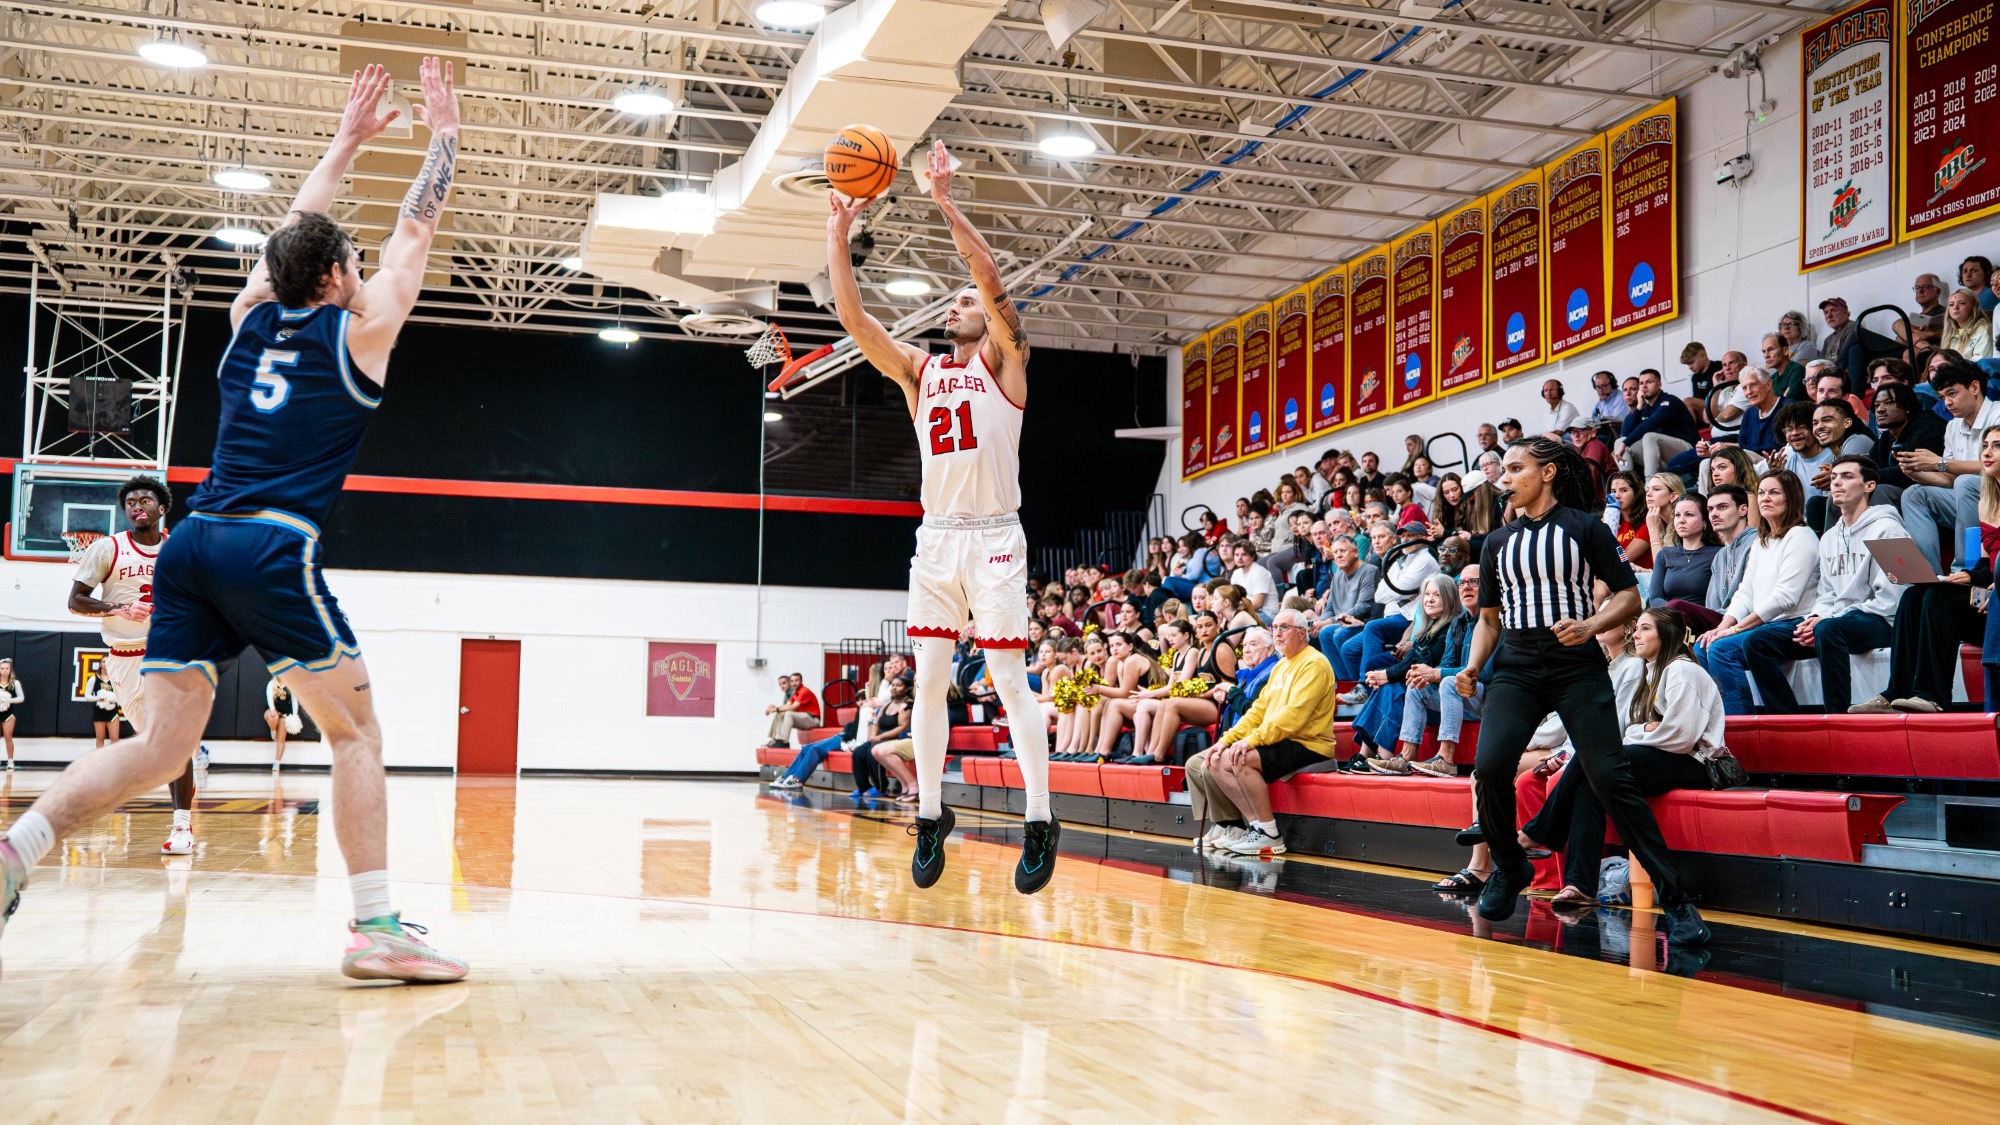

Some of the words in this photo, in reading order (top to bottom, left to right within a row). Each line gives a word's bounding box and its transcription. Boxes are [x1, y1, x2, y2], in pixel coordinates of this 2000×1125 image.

[1806, 9, 1889, 76] FLAGLER
[1917, 3, 1994, 52] CONFERENCE
[1920, 26, 1989, 68] CHAMPIONS
[1814, 52, 1880, 95] INSTITUTION
[1914, 89, 1936, 109] 2013
[1944, 77, 1966, 97] 2018
[1975, 64, 1997, 85] 2019
[1812, 96, 1824, 113] OF
[1829, 85, 1849, 107] THE
[1854, 71, 1881, 95] YEAR
[1914, 107, 1936, 127] 2020
[1944, 96, 1966, 116] 2021
[1974, 83, 1997, 104] 2022
[1812, 117, 1842, 139] 2010-11
[1850, 100, 1882, 124] 2011-12
[1812, 134, 1842, 156] 2012-13
[1850, 117, 1882, 141] 2013-14
[1914, 125, 1936, 144] 2023
[1943, 114, 1966, 134] 2024
[1612, 116, 1672, 171] FLAGLER
[1813, 150, 1843, 172] 2014-15
[1850, 135, 1882, 158] 2015-16
[1548, 149, 1602, 203] FLAGLER
[1615, 160, 1669, 195] CHAMPIONSHIP
[1622, 149, 1659, 176] NATIONAL
[1813, 167, 1843, 188] 2017-18
[1850, 151, 1883, 175] 2018-19
[1935, 144, 1974, 192] PBC
[424, 200, 437, 219] OF
[433, 161, 452, 201] ONE
[1558, 181, 1591, 207] NATIONAL
[1616, 176, 1668, 209] APPEARANCES
[1910, 207, 1941, 226] WOMEN'S
[1943, 199, 1964, 215] CROSS
[1966, 186, 2000, 208] COUNTRY
[1492, 184, 1540, 232] FLAGLER
[1551, 190, 1600, 225] CHAMPIONSHIP
[1553, 206, 1600, 239] APPEARANCES
[1616, 209, 1630, 224] 2018
[1635, 201, 1649, 216] 2019
[1654, 193, 1668, 208] 2024
[1829, 187, 1861, 228] PBC
[1441, 208, 1484, 253] FLAGLER
[1494, 224, 1537, 253] CHAMPIONSHIP
[1500, 213, 1531, 237] NATIONAL
[1617, 223, 1630, 238] 2025
[1394, 233, 1433, 275] FLAGLER
[1445, 241, 1478, 266] CONFERENCE
[1495, 239, 1537, 267] APPEARANCES
[1553, 238, 1566, 253] 2016
[1809, 235, 1859, 259] SPORTSMANSHIP
[1861, 227, 1885, 242] AWARD
[1447, 256, 1476, 278] CHAMPIONS
[1631, 280, 1653, 298] NCAA
[1568, 305, 1588, 323] NCAA
[1613, 314, 1631, 327] WOMEN'S
[1632, 308, 1646, 321] TRACK
[1648, 304, 1657, 315] AND
[1658, 300, 1672, 312] FIELD
[1508, 329, 1524, 345] NCAA
[1553, 340, 1565, 351] MEN'S
[1567, 333, 1580, 346] TRACK
[1581, 329, 1590, 340] AND
[1591, 324, 1603, 336] FIELD
[248, 347, 301, 414] 5
[1406, 367, 1420, 381] NCAA
[929, 400, 978, 456] 21
[119, 564, 154, 580] FLAG
[989, 554, 1013, 564] PBC
[653, 659, 710, 679] FLAGLER
[671, 674, 692, 683] Saints
